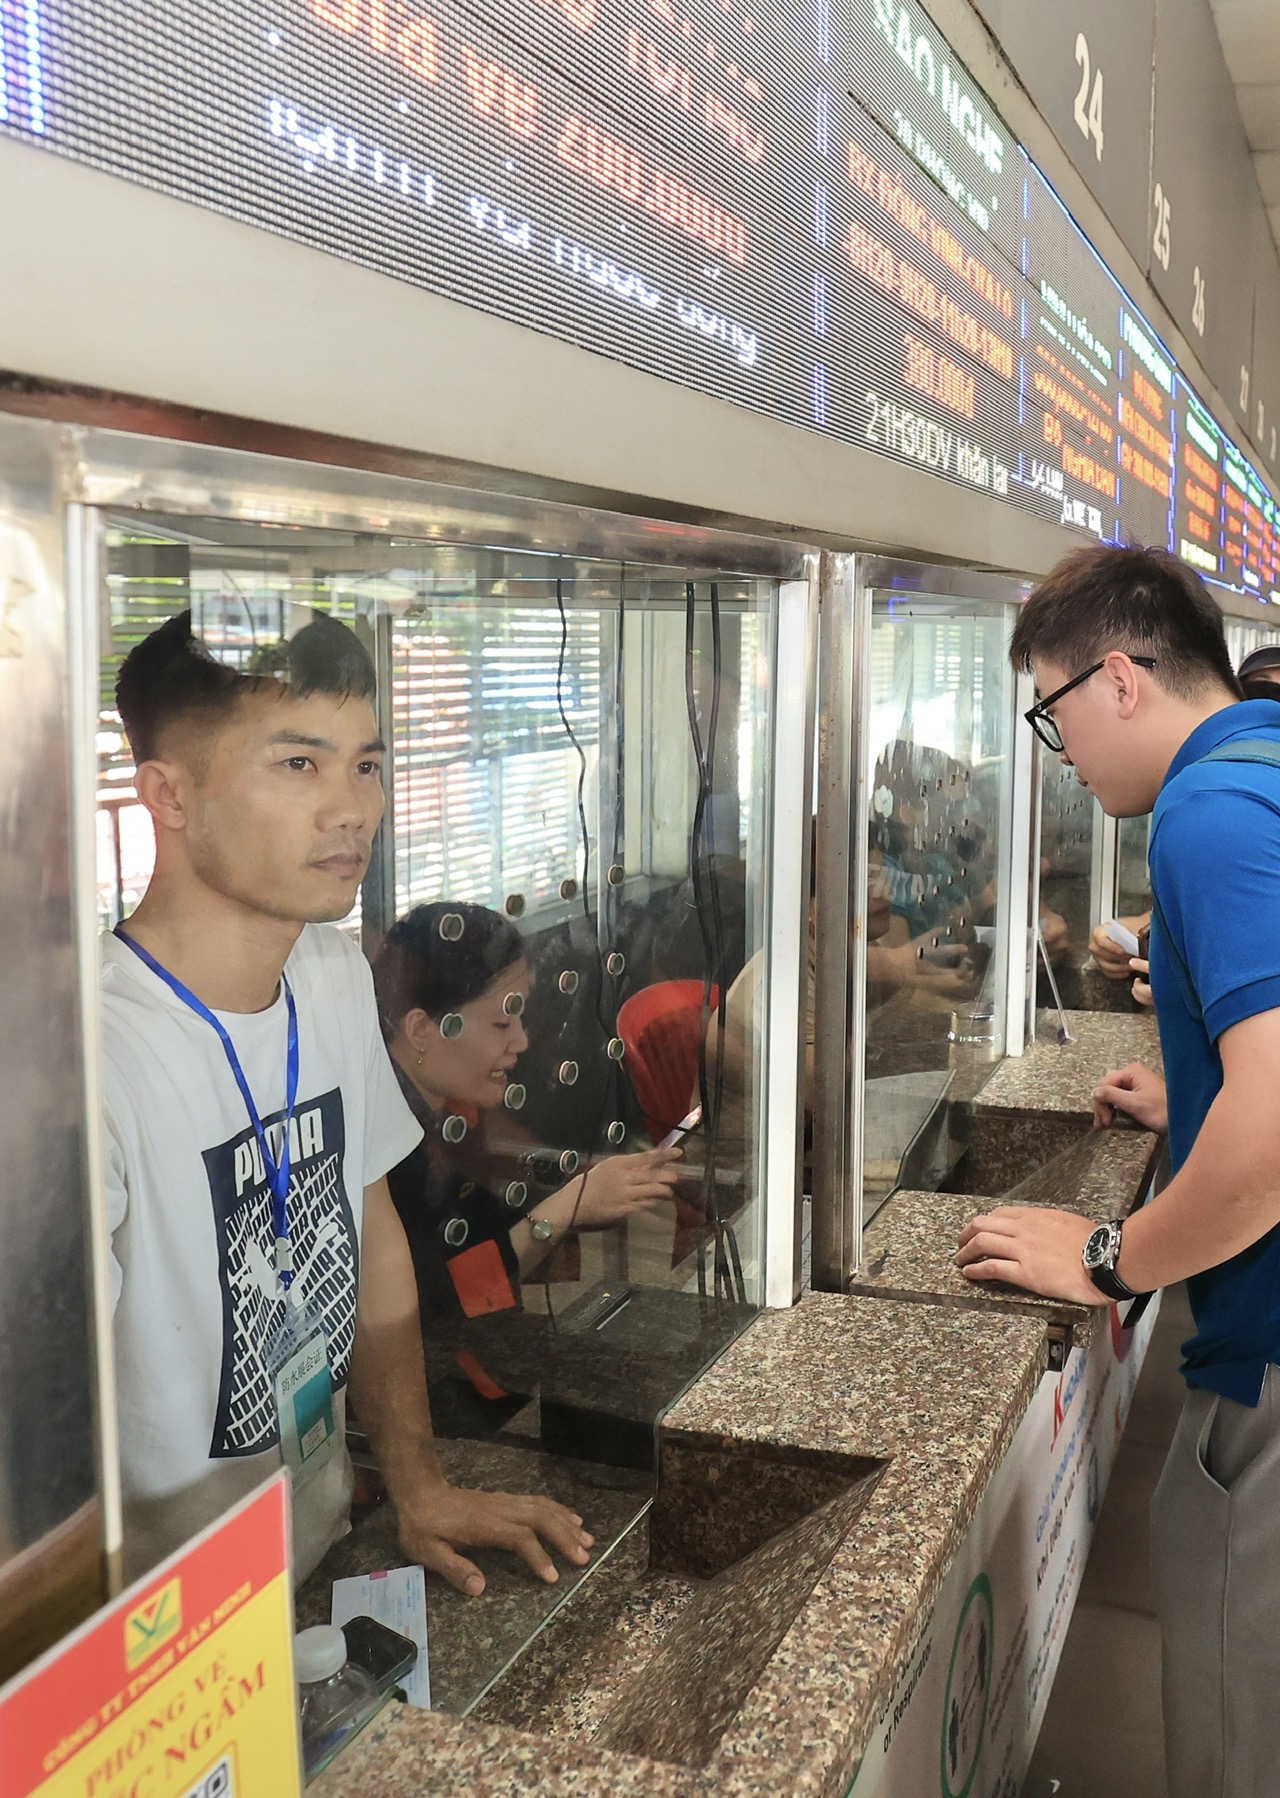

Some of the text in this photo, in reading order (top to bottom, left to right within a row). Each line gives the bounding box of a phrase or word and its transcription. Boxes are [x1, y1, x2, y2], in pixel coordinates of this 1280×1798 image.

[1074, 32, 1104, 162] 24
[1152, 182, 1171, 271] 25
[1192, 266, 1205, 338] 26
[234, 1107, 324, 1198] PUMA
[893, 1636, 934, 1731] Respirator
